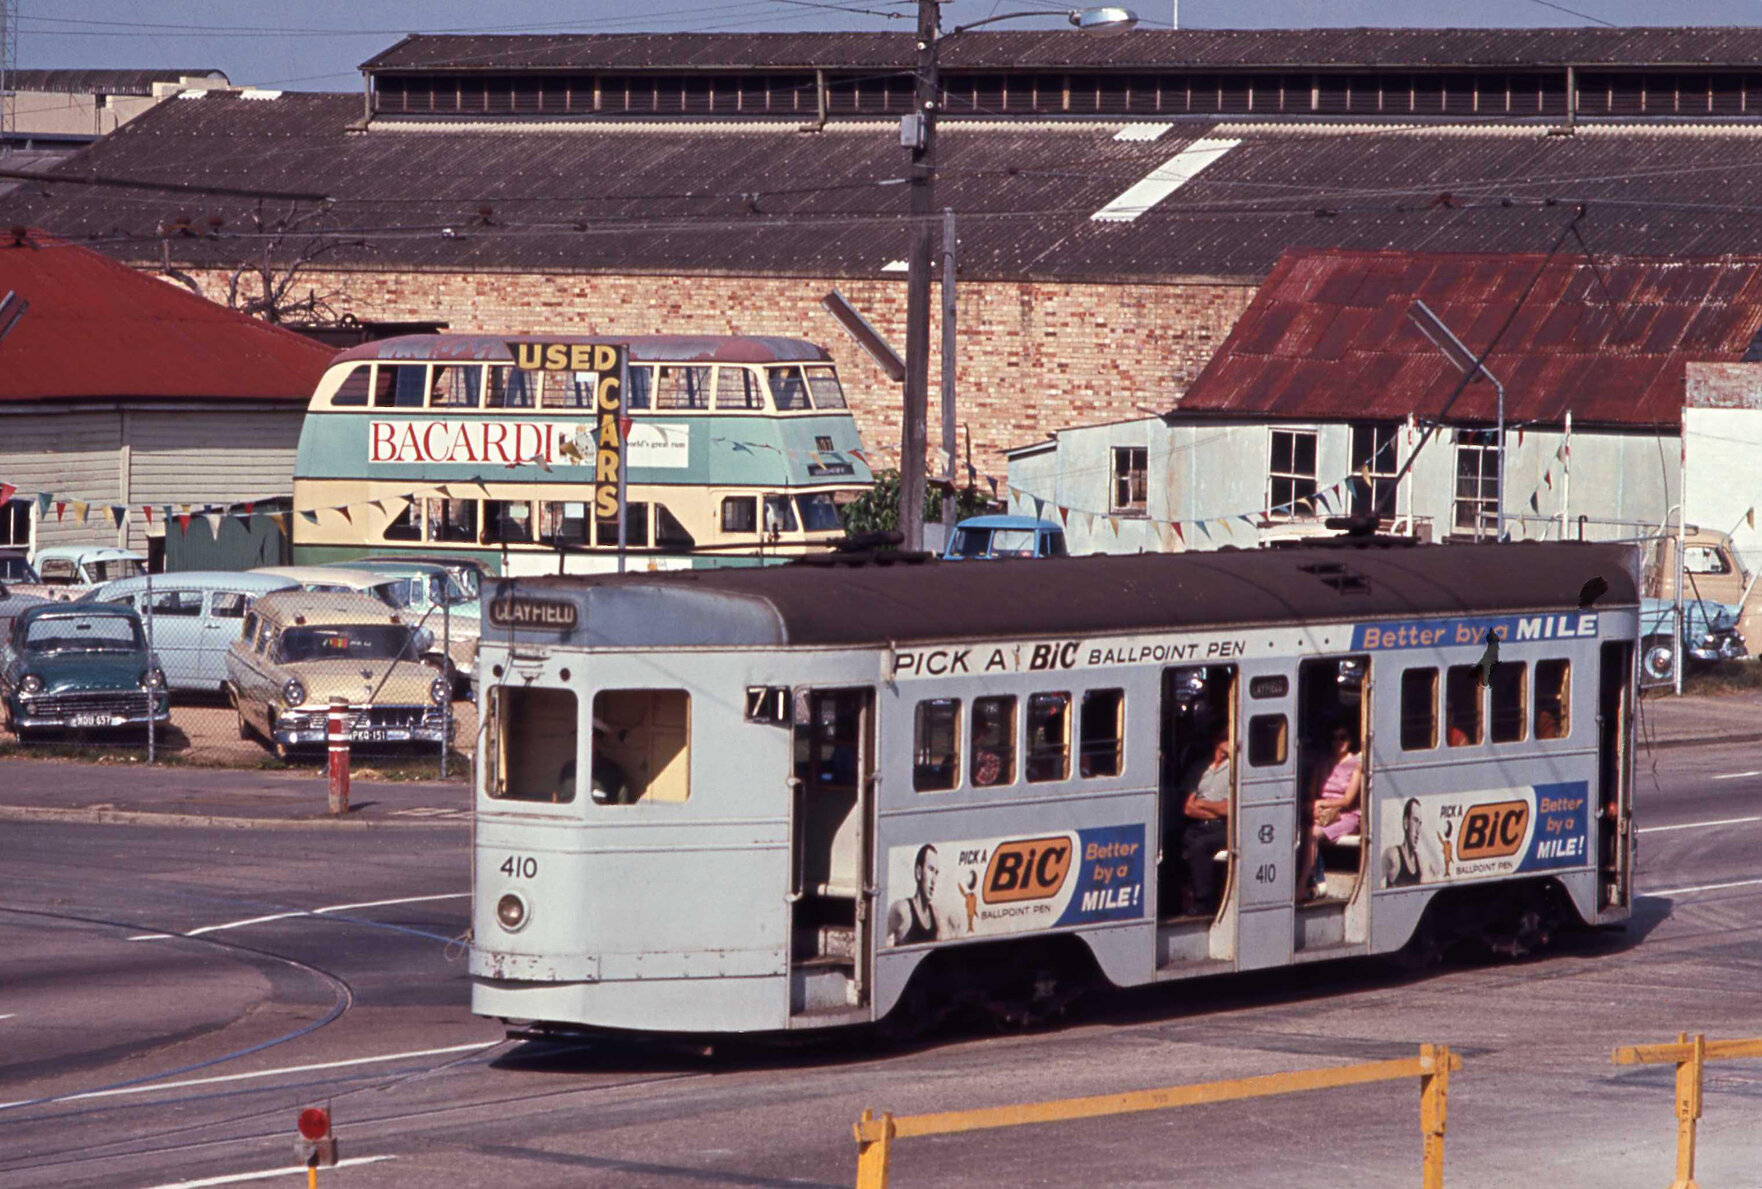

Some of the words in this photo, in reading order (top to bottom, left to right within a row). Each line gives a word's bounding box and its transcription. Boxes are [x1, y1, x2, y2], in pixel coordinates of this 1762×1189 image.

[518, 344, 617, 371] USED
[371, 420, 553, 462] BACARDI
[596, 377, 620, 517] CARS
[495, 603, 574, 623] CLAYFIELD
[1362, 626, 1446, 649] Better
[1455, 623, 1487, 644] by
[1516, 614, 1598, 640] MILE
[894, 650, 971, 675] PICK
[985, 649, 1006, 671] A
[1088, 643, 1200, 665] BALLPOINT
[1206, 640, 1246, 659] PEN
[749, 688, 784, 720] 71
[1540, 797, 1583, 813] Better
[1546, 817, 1563, 834] by
[1565, 818, 1574, 829] a
[958, 849, 980, 865] PICK
[980, 849, 987, 862] A
[1085, 842, 1139, 860] Better
[1537, 835, 1585, 859] MILE!
[500, 855, 538, 879] 410
[1093, 864, 1114, 884] by
[1116, 865, 1128, 878] a
[1255, 863, 1276, 884] 410
[1456, 863, 1495, 875] BALLPOINT
[1498, 861, 1513, 869] PEN
[1081, 884, 1141, 912] MILE!
[981, 906, 1031, 920] BALLPOINT
[1033, 905, 1051, 915] PEN
